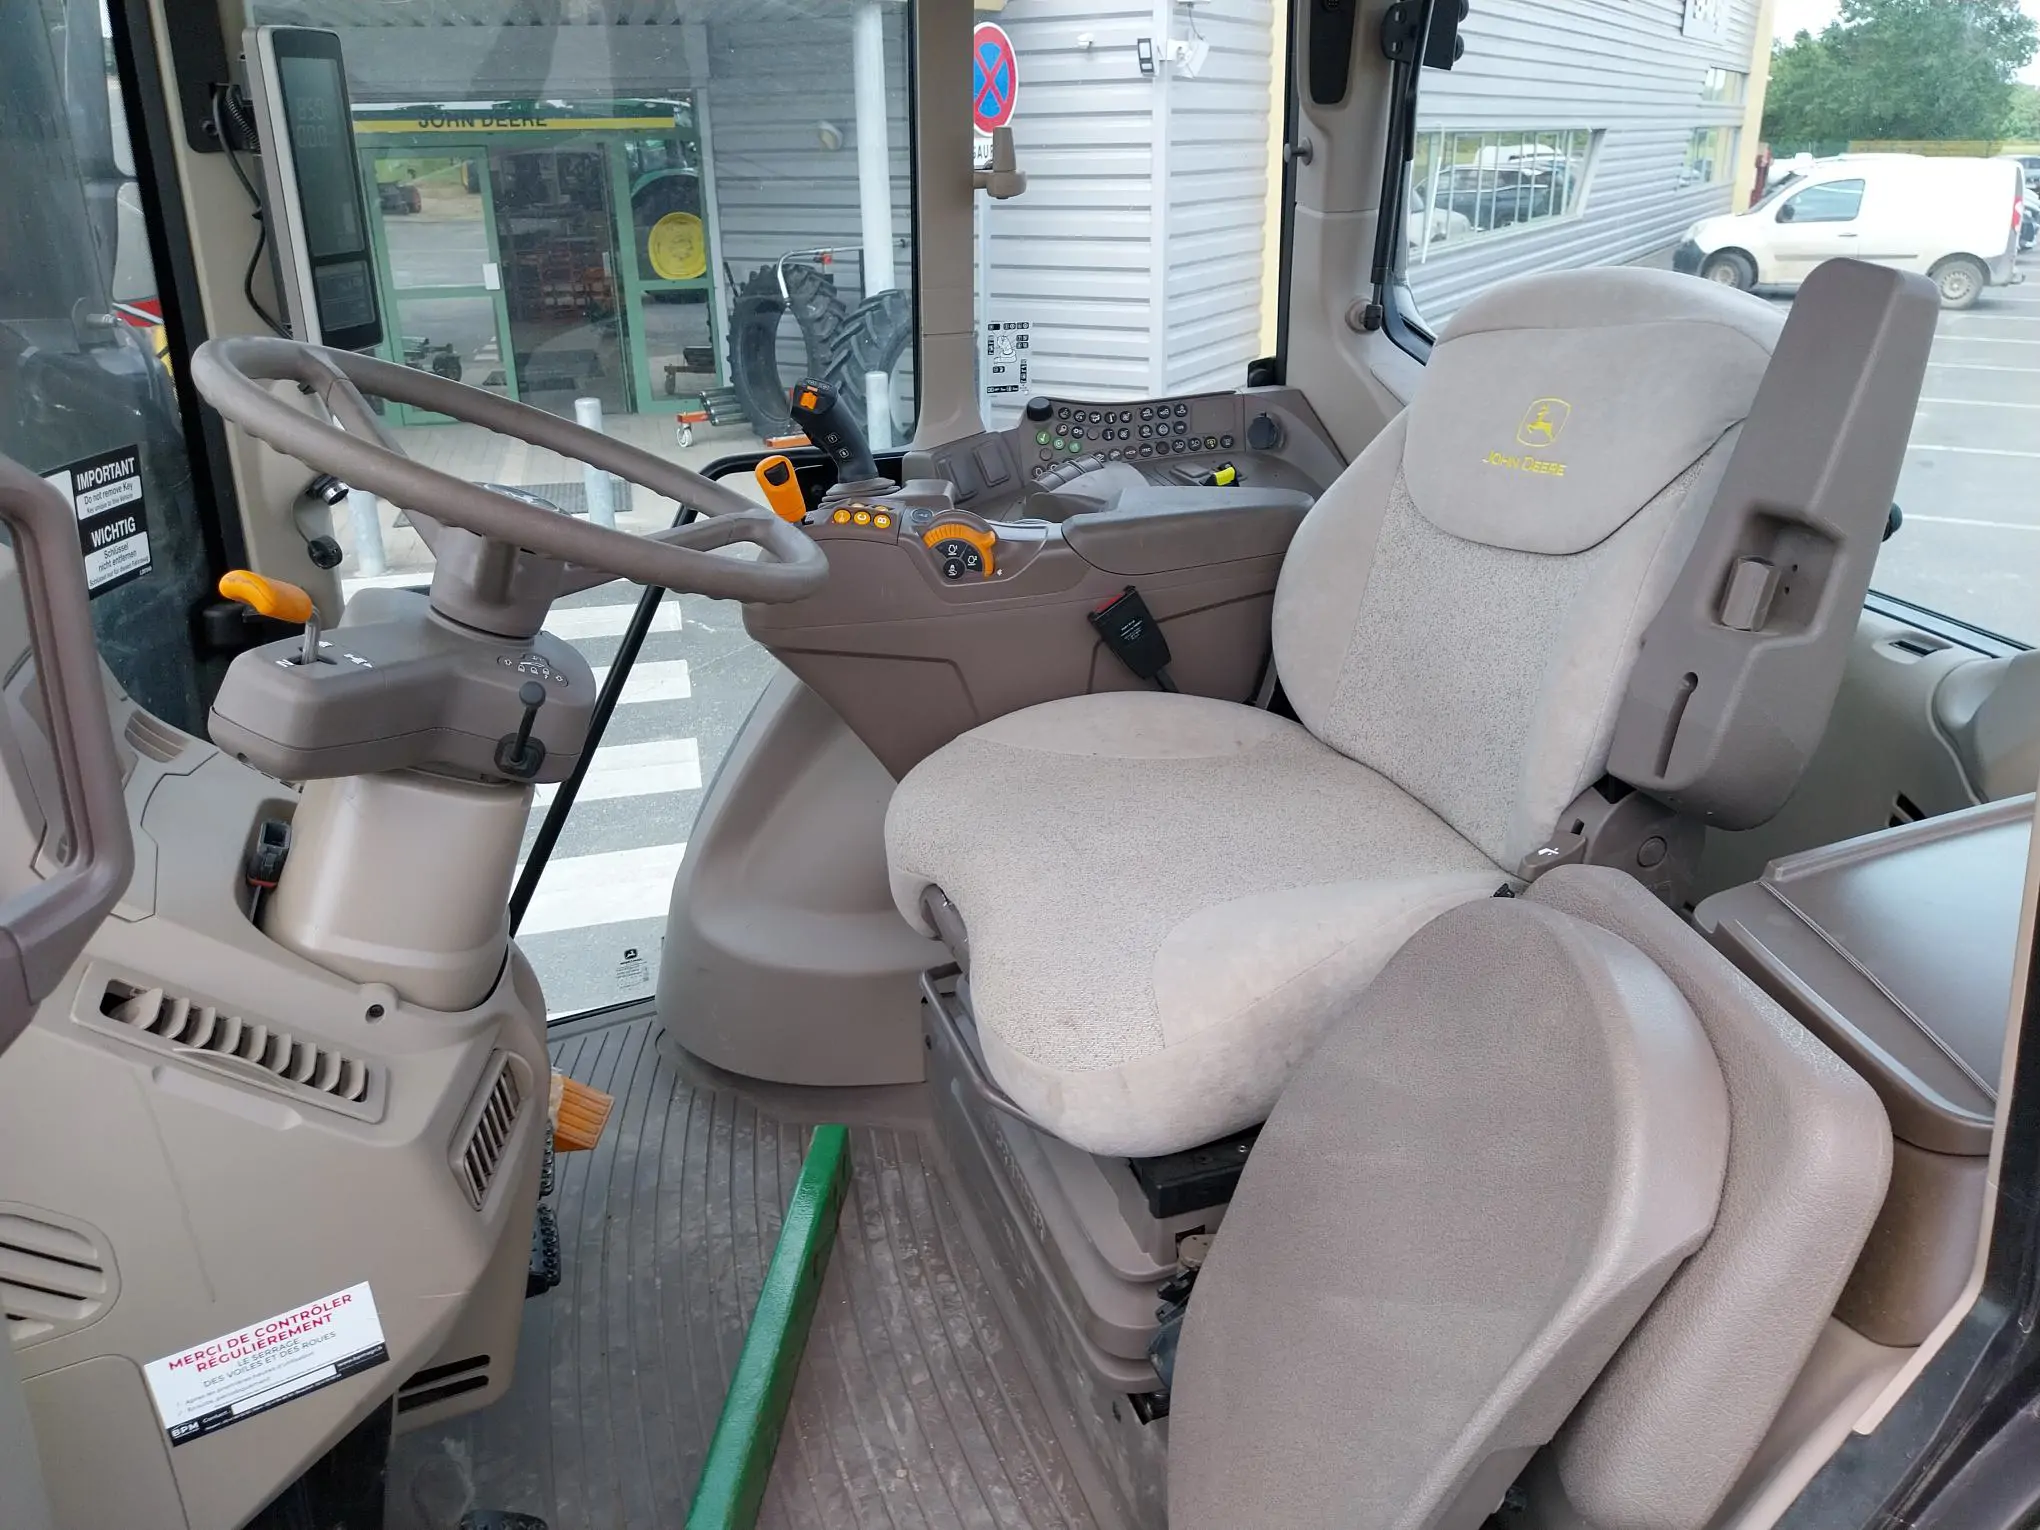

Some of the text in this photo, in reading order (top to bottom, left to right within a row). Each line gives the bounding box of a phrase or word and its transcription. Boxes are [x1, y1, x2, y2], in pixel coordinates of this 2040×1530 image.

[418, 116, 547, 128] JOHN DEERE
[77, 457, 135, 491] IMPORTANT
[1482, 450, 1568, 476] JOHN DEERE
[84, 481, 133, 505] Do not remove Key
[91, 516, 136, 548] WICHTIG
[98, 550, 137, 572] nicht entfernen
[104, 542, 129, 559] Schlüssel
[168, 1293, 353, 1371] MERCI DE CONTRÔLER
[196, 1312, 333, 1373] RÉGULIÈREMENT
[203, 1330, 337, 1389] DES VOILES ET DES ROUES
[236, 1338, 300, 1367] LE SERRAGE
[171, 1421, 200, 1438] BPM
